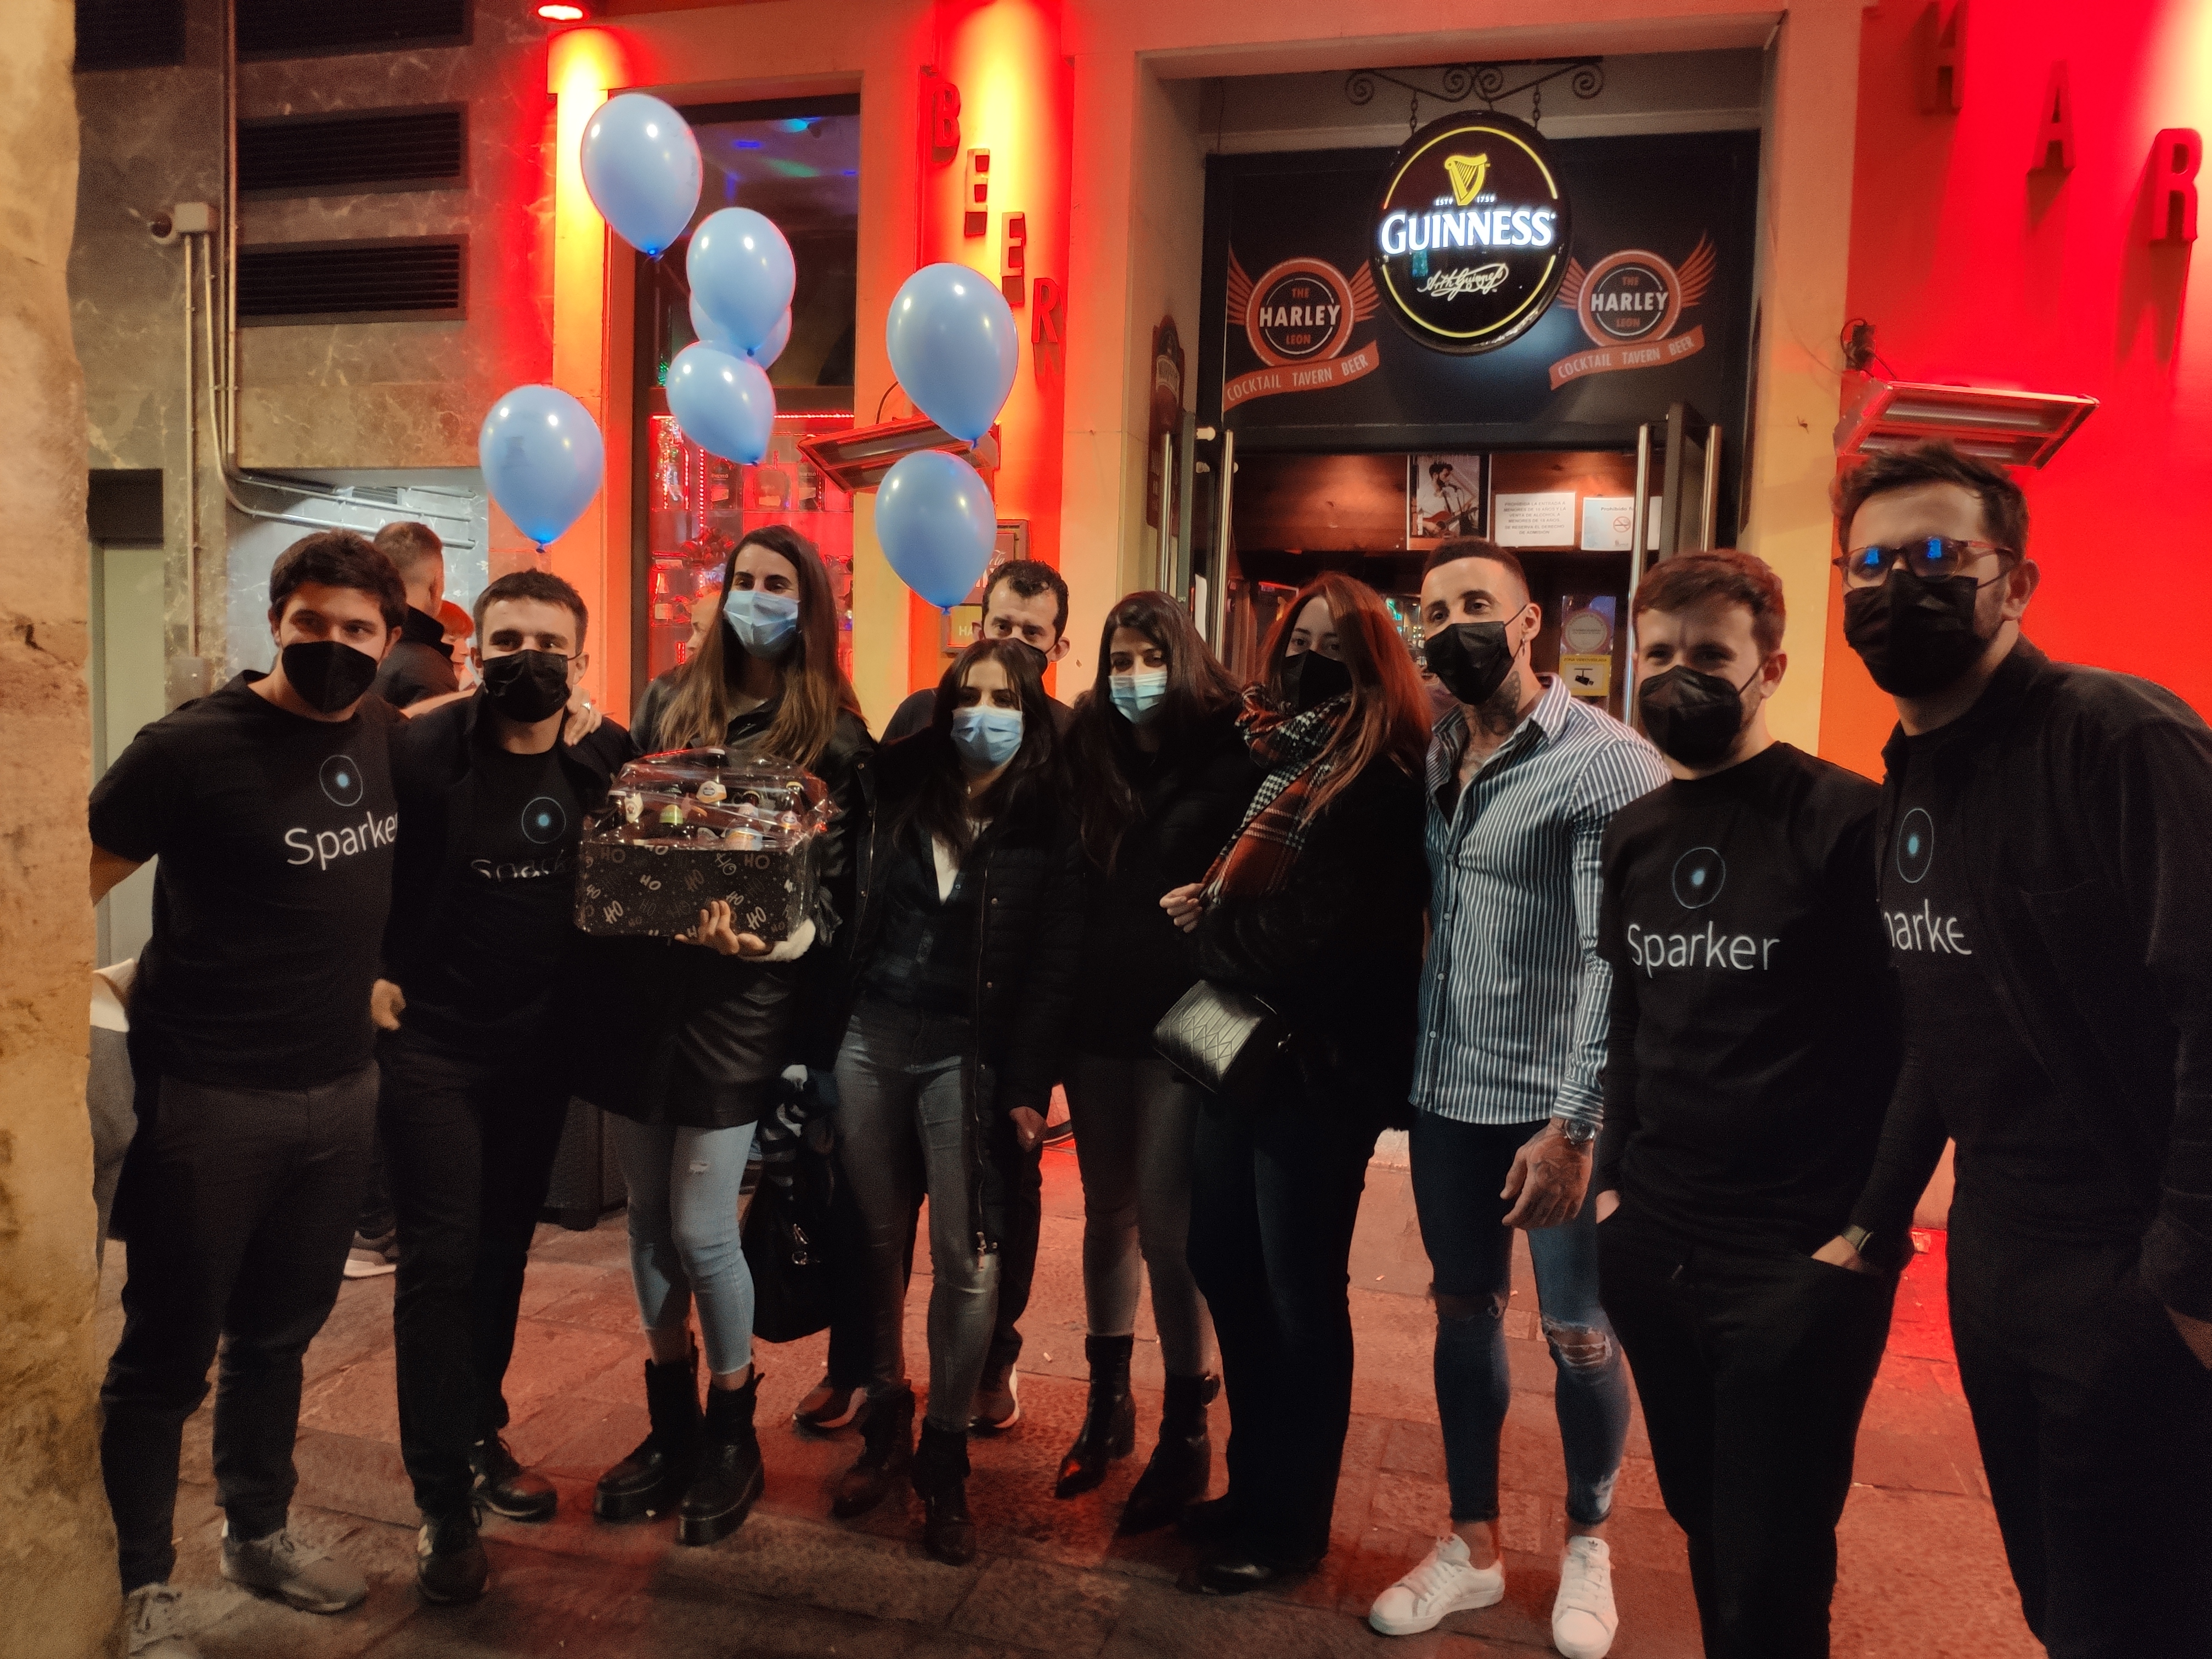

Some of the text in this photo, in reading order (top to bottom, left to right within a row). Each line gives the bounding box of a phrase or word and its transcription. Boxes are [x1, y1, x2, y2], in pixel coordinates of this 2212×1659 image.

[934, 82, 1063, 345] BEER
[1381, 210, 1553, 255] GUINNESS
[1622, 276, 1639, 286] THE
[1291, 287, 1310, 298] THE
[1591, 292, 1668, 312] HARLEY
[1259, 304, 1340, 328] HARLEY
[1616, 318, 1641, 328] LEON
[1285, 334, 1311, 345] LEON
[1558, 336, 1695, 379] COCKTAIL TAVERN BEER
[1227, 354, 1369, 401] COCKTAIL TAVERN BEER
[744, 853, 770, 870] HO
[640, 874, 662, 890] HO
[726, 891, 744, 905] HO
[603, 900, 623, 924] HO
[746, 906, 766, 930] HO
[1627, 921, 1780, 978] Sparker
